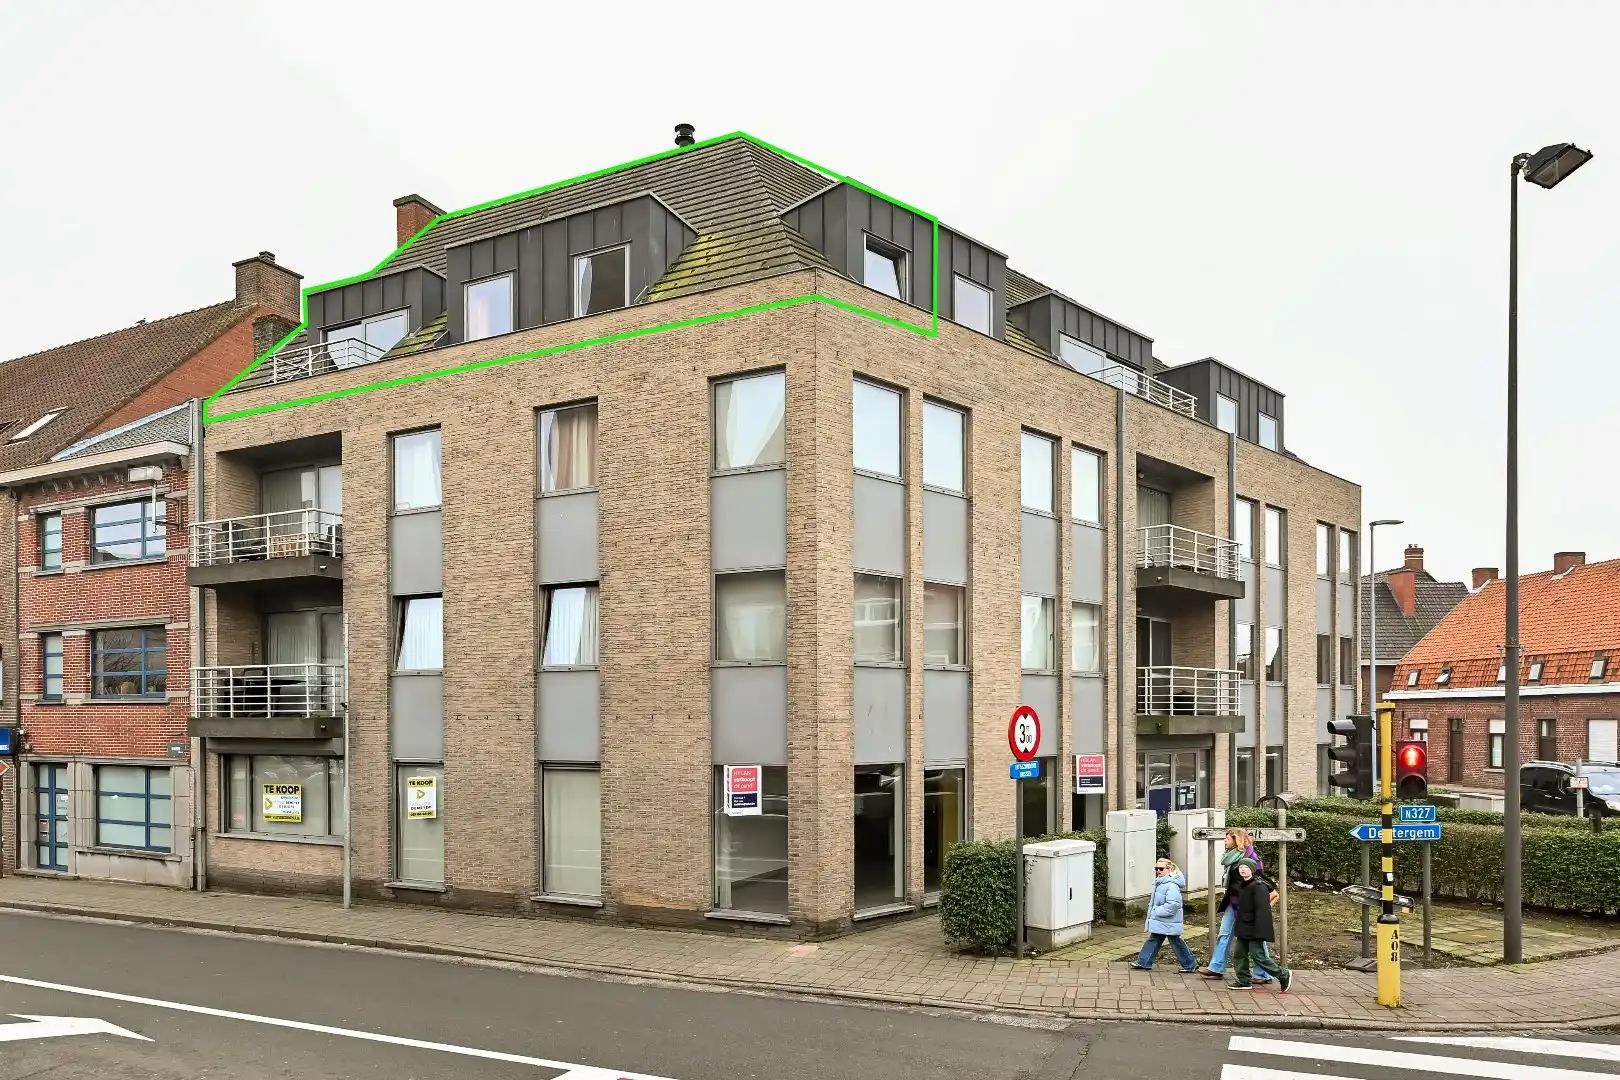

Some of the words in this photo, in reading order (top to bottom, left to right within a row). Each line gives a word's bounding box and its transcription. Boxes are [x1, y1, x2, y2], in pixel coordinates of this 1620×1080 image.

[1019, 723, 1026, 744] 3
[264, 785, 274, 794] TE
[276, 785, 299, 795] KOOP
[1405, 807, 1431, 819] N327
[1369, 827, 1435, 841] Detergem
